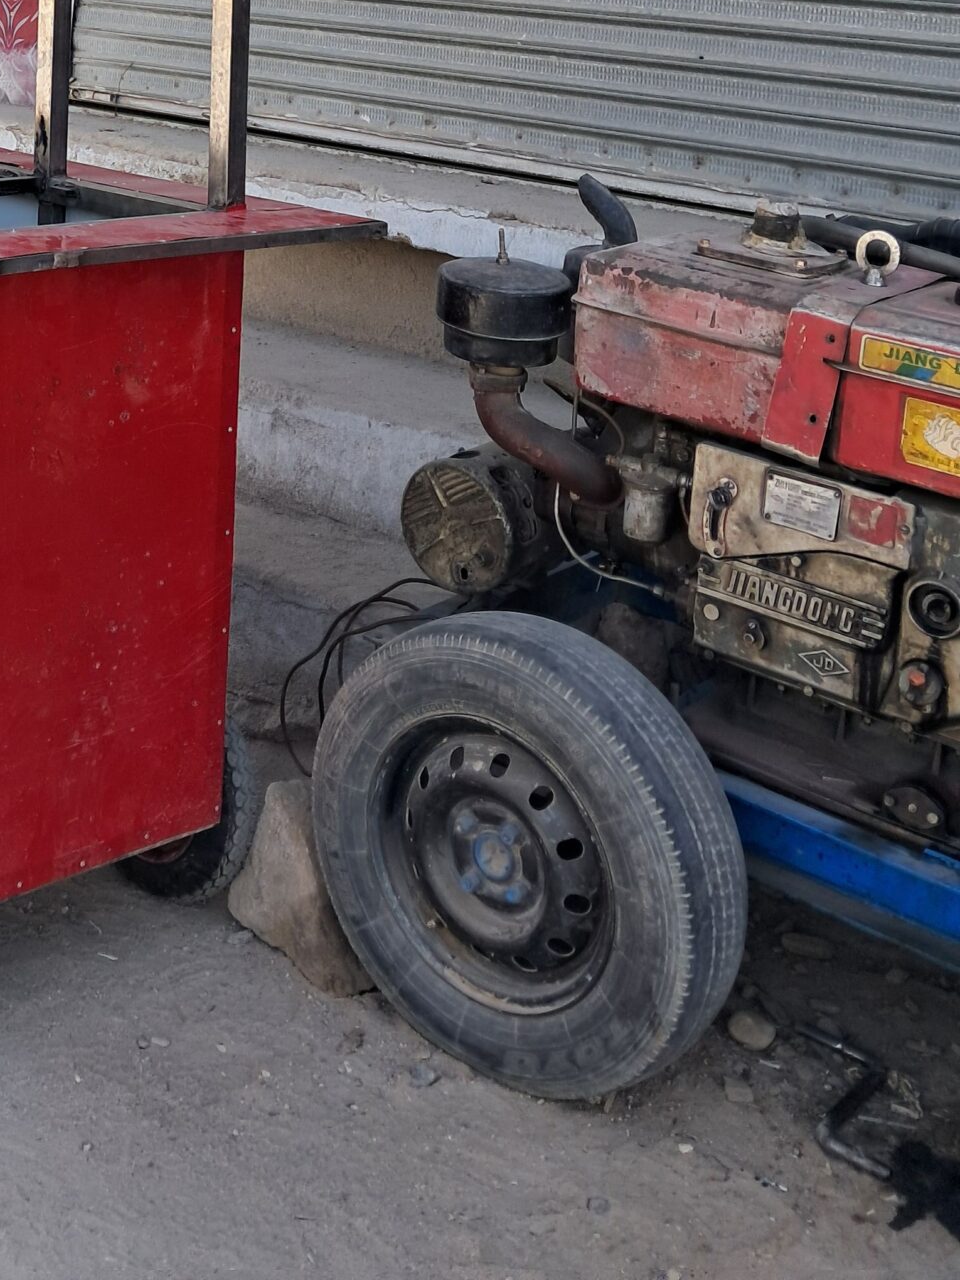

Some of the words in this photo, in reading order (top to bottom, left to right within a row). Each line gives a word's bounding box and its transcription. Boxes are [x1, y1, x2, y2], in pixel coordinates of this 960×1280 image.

[883, 346, 942, 370] JIANG
[727, 570, 855, 633] JIANGDONG
[812, 655, 835, 672] JD
